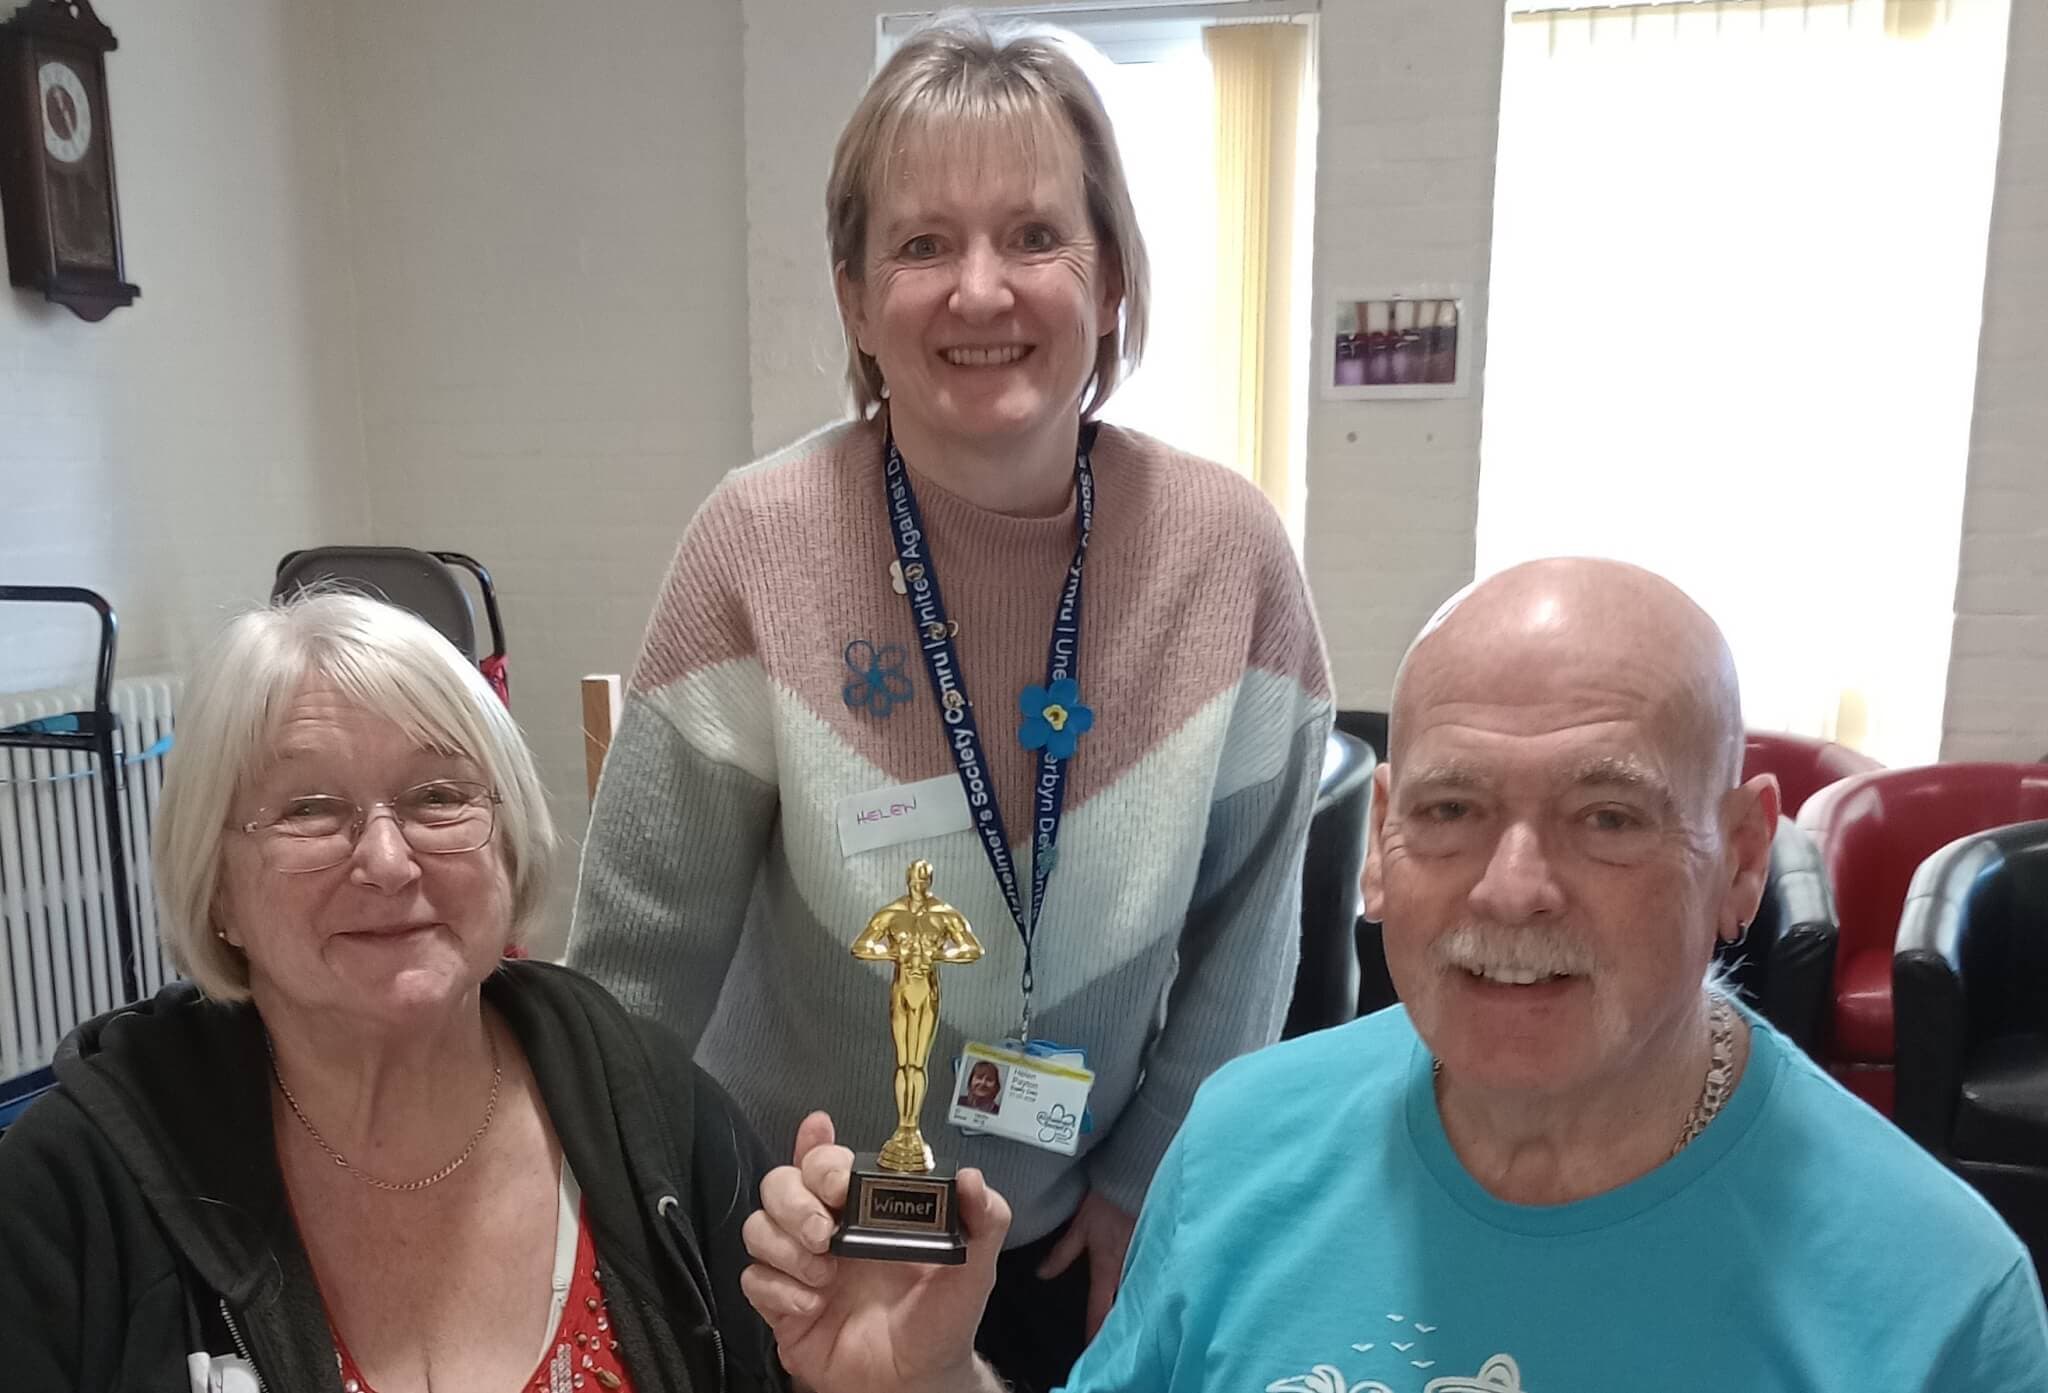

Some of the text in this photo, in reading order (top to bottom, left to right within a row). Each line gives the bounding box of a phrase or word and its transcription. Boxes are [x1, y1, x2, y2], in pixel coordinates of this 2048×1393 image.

[890, 475, 921, 558] Against
[906, 563, 946, 639] Unite
[1059, 555, 1083, 622] ymru
[932, 653, 965, 724] Cmru
[953, 728, 988, 807] Society
[856, 794, 917, 825] HELEN
[874, 1195, 934, 1216] Winner
